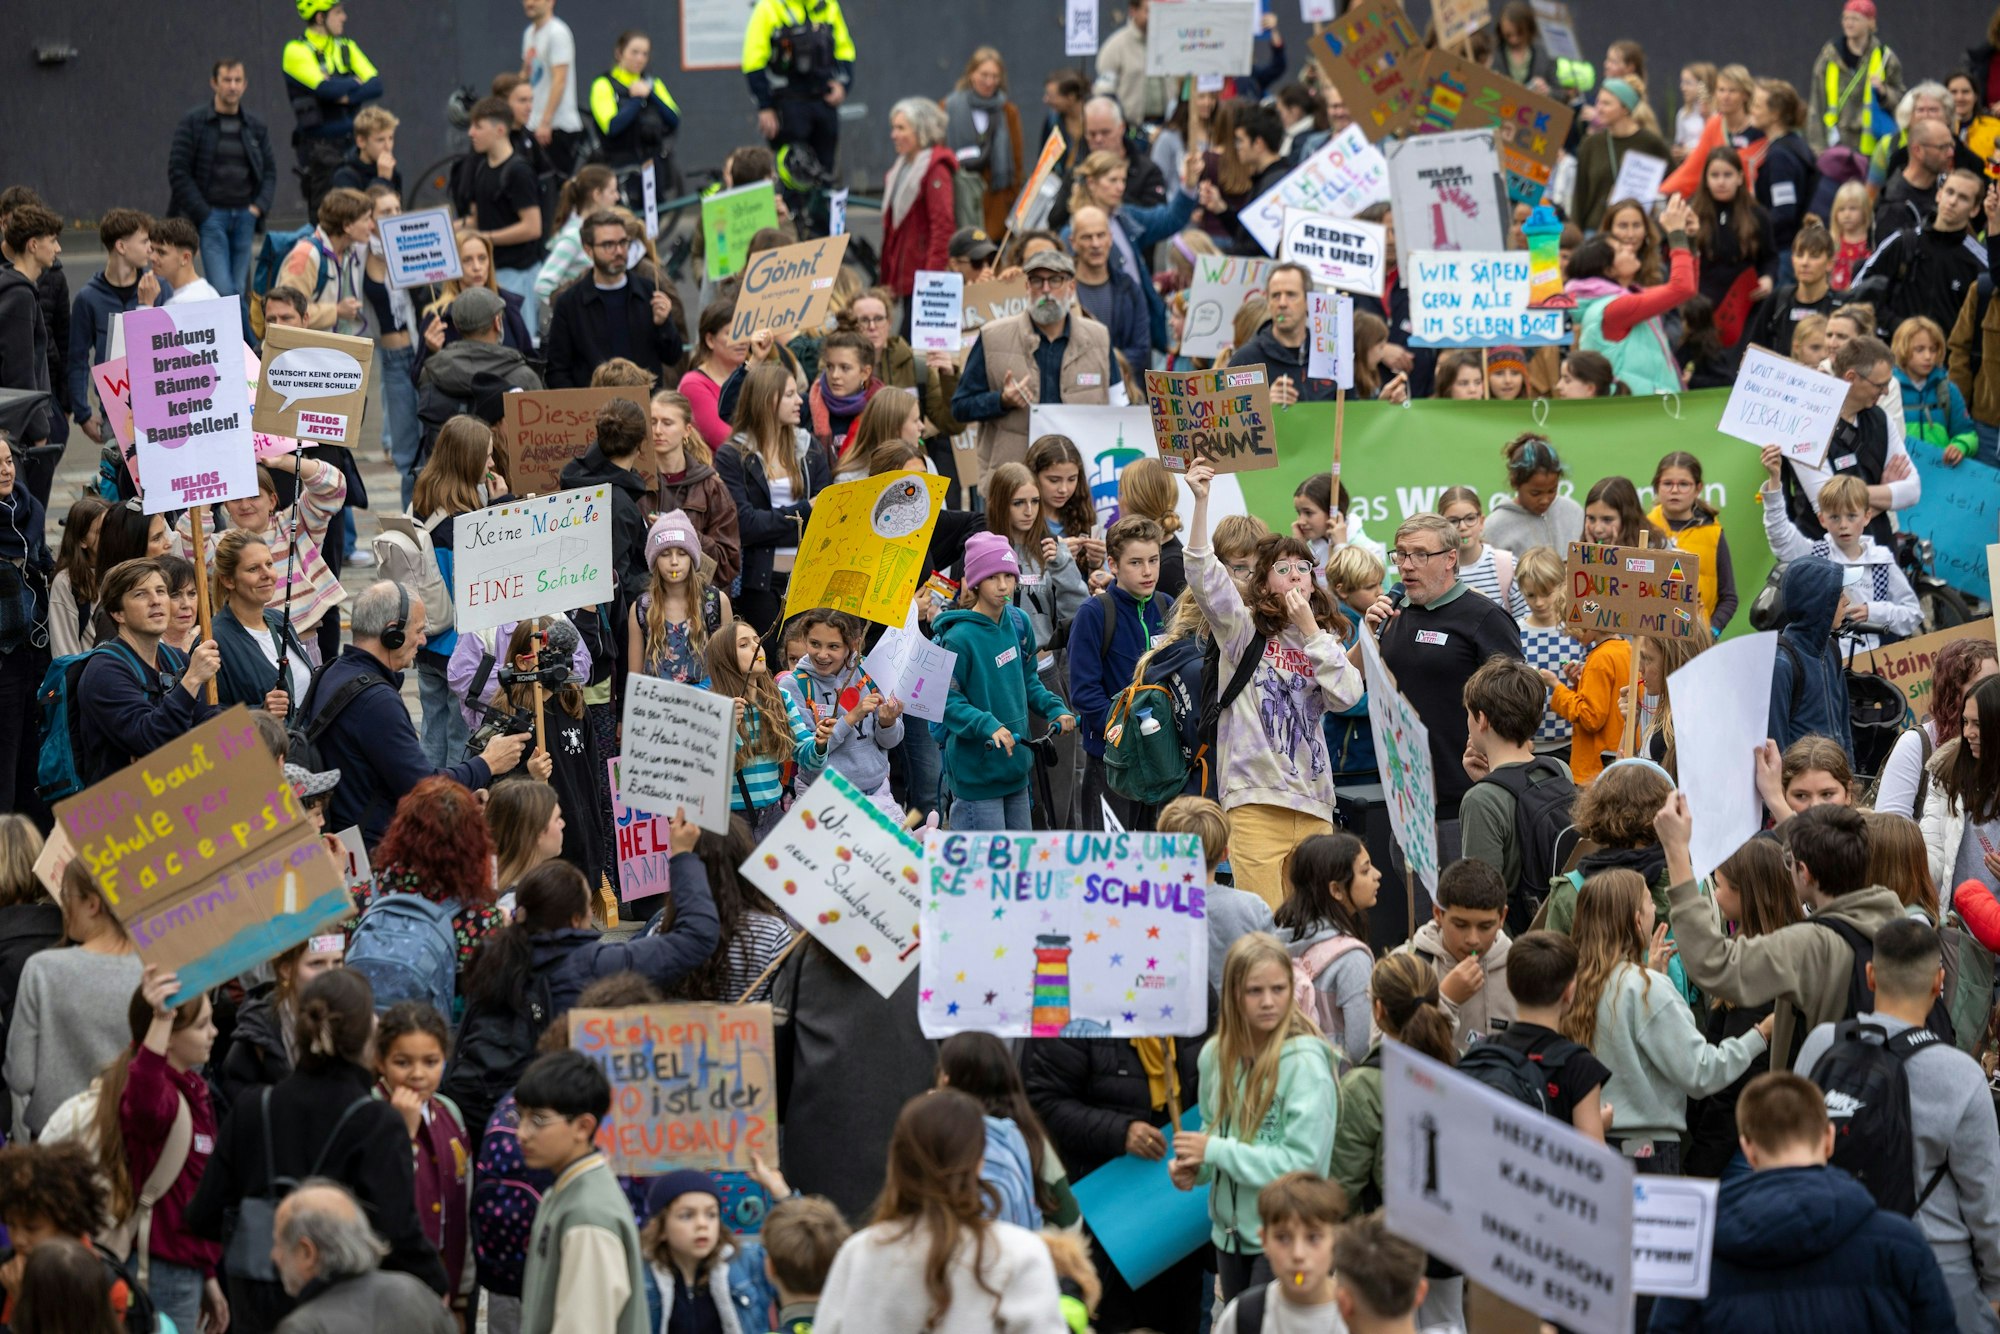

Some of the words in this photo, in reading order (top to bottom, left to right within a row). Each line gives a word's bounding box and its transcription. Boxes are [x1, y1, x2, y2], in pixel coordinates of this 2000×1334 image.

[1418, 166, 1464, 180] HELIOS
[1304, 224, 1366, 249] REDET
[1294, 241, 1325, 260] mit
[1330, 247, 1374, 268] UNS!
[746, 242, 826, 294] Gönnt
[1419, 262, 1459, 282] WIR
[1422, 292, 1462, 310] GERN
[1472, 292, 1513, 310] ALLE
[732, 294, 814, 341] W-lan!
[1424, 317, 1443, 333] IM
[1453, 314, 1514, 335] SELBEN
[1520, 313, 1561, 336] BOOT
[152, 328, 216, 351] Bildung
[153, 349, 219, 374] braucht
[269, 368, 308, 378] QUATSCHT
[309, 371, 332, 379] KEINE
[333, 372, 361, 380] OPERN!
[155, 376, 211, 396] Räume
[293, 381, 323, 389] UNSERE
[325, 382, 357, 390] SCHULE!
[168, 397, 213, 417] keine
[301, 413, 340, 425] HELIOS
[1187, 400, 1216, 418] VON
[146, 412, 239, 444] Baustellen!
[307, 425, 344, 436] JETZT!
[1177, 416, 1229, 432] BRAUCHEN
[1240, 412, 1262, 426] WIR
[518, 429, 575, 446] Plakat
[1191, 425, 1273, 463] RÄUME
[171, 471, 220, 491] HELIOS
[182, 483, 228, 503] JETZT!
[465, 521, 522, 550] Keine
[531, 504, 599, 537] Module
[469, 575, 525, 607] EINE
[537, 563, 598, 593] Schule
[1639, 614, 1667, 631] MIT
[64, 789, 143, 839] Köln,
[141, 742, 215, 797] baut
[216, 724, 257, 762] ihr
[82, 810, 175, 876] Schule
[182, 786, 231, 835] per
[100, 783, 297, 905] Flaschenpost?
[819, 806, 851, 840] Wir
[853, 844, 898, 886] wollen
[943, 834, 1037, 872] GEBT
[1065, 832, 1130, 866] UNS
[245, 859, 286, 891] nie
[289, 842, 324, 868] an
[930, 866, 974, 896] RE
[991, 870, 1077, 901] NEUE
[1083, 873, 1206, 919] SCHULE
[584, 1013, 707, 1050] Stehen
[718, 1013, 759, 1043] im
[1907, 1029, 1934, 1046] NIKE
[652, 1080, 701, 1116] ist
[710, 1079, 760, 1110] der
[1493, 1115, 1604, 1183] HEIZUNG
[1481, 1214, 1614, 1296] INKLUSION
[1491, 1257, 1536, 1290] AUF
[1542, 1279, 1592, 1316] EIS?
